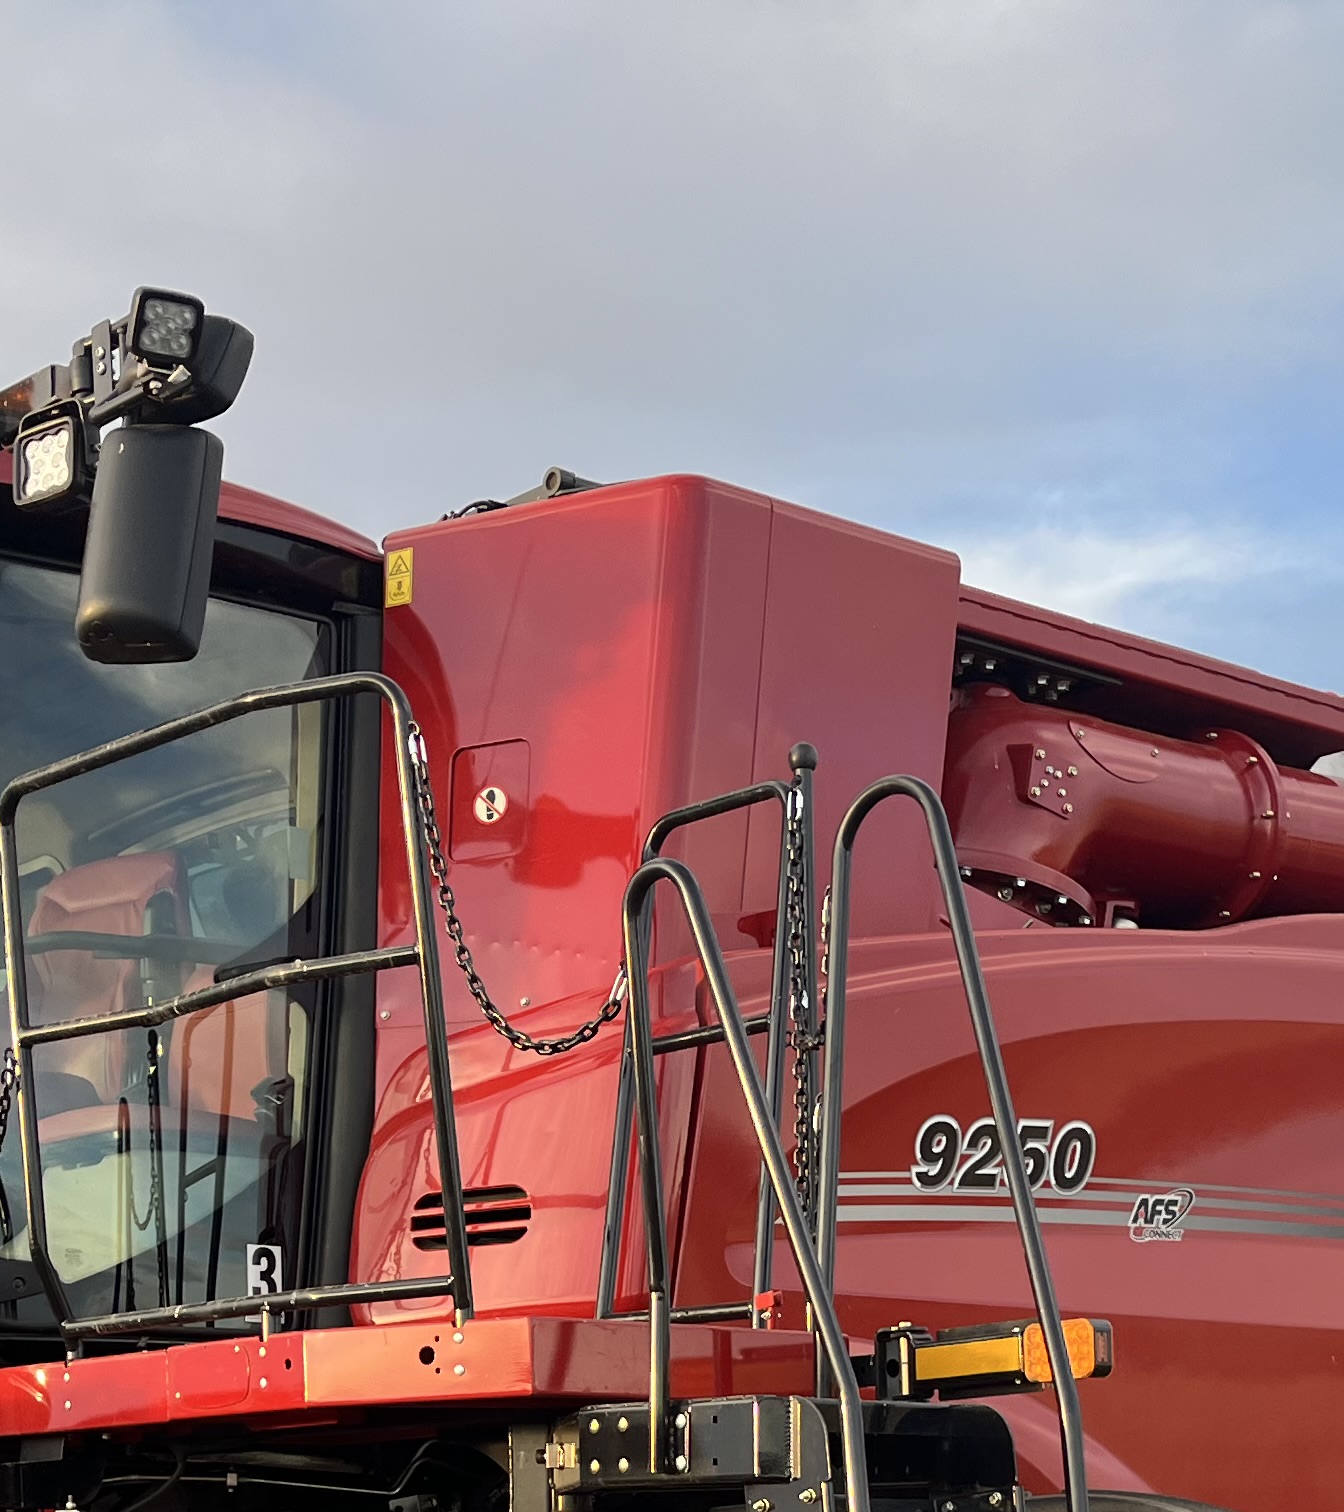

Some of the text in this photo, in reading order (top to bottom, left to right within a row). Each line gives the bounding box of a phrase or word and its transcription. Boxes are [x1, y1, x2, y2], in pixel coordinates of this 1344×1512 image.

[911, 1114, 1096, 1195] 9250
[1130, 1196, 1180, 1225] AFS
[1143, 1229, 1183, 1240] CONNECT
[252, 1247, 278, 1296] 3
